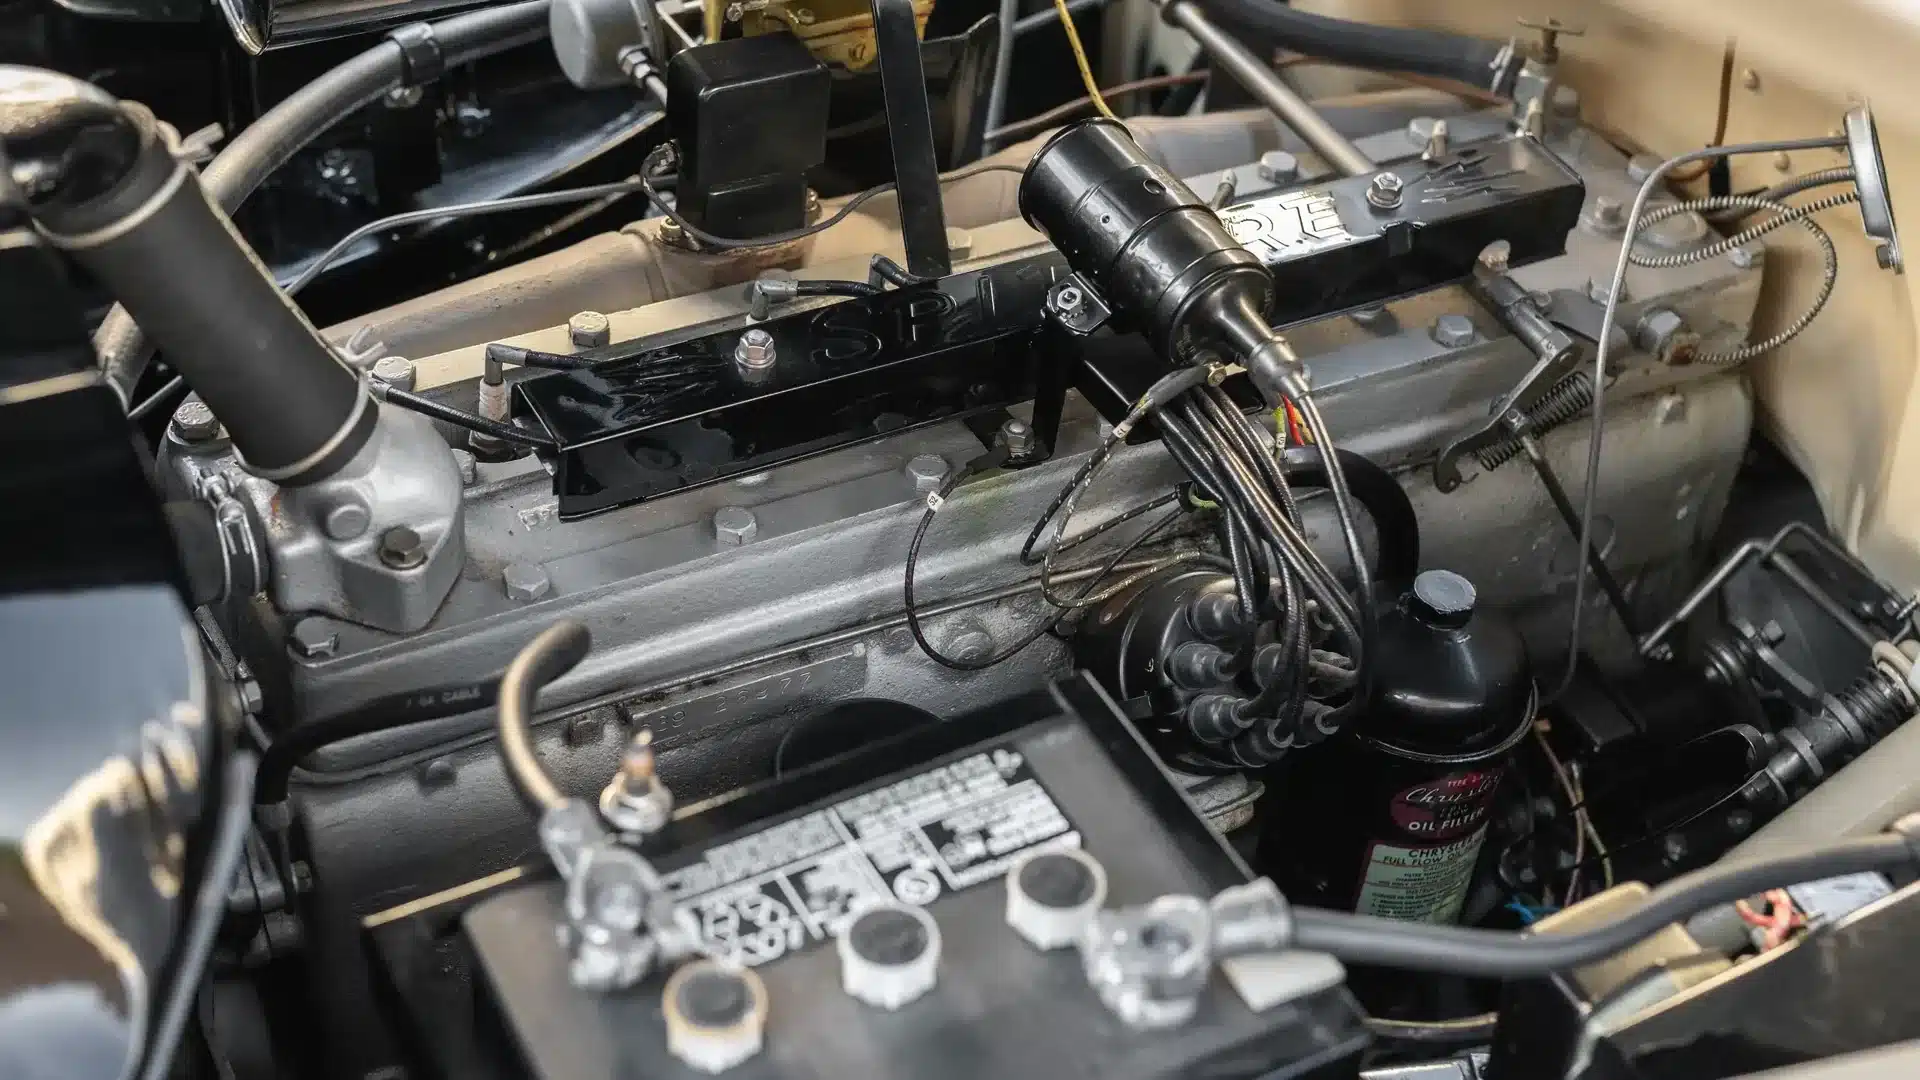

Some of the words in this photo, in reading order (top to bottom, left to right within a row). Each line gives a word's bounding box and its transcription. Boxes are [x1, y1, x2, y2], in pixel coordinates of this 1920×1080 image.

[928, 495, 939, 507] 52
[1408, 821, 1435, 831] OIL
[1441, 806, 1485, 830] FILTER
[1383, 855, 1407, 866] FULL
[1412, 856, 1443, 866] FLOW
